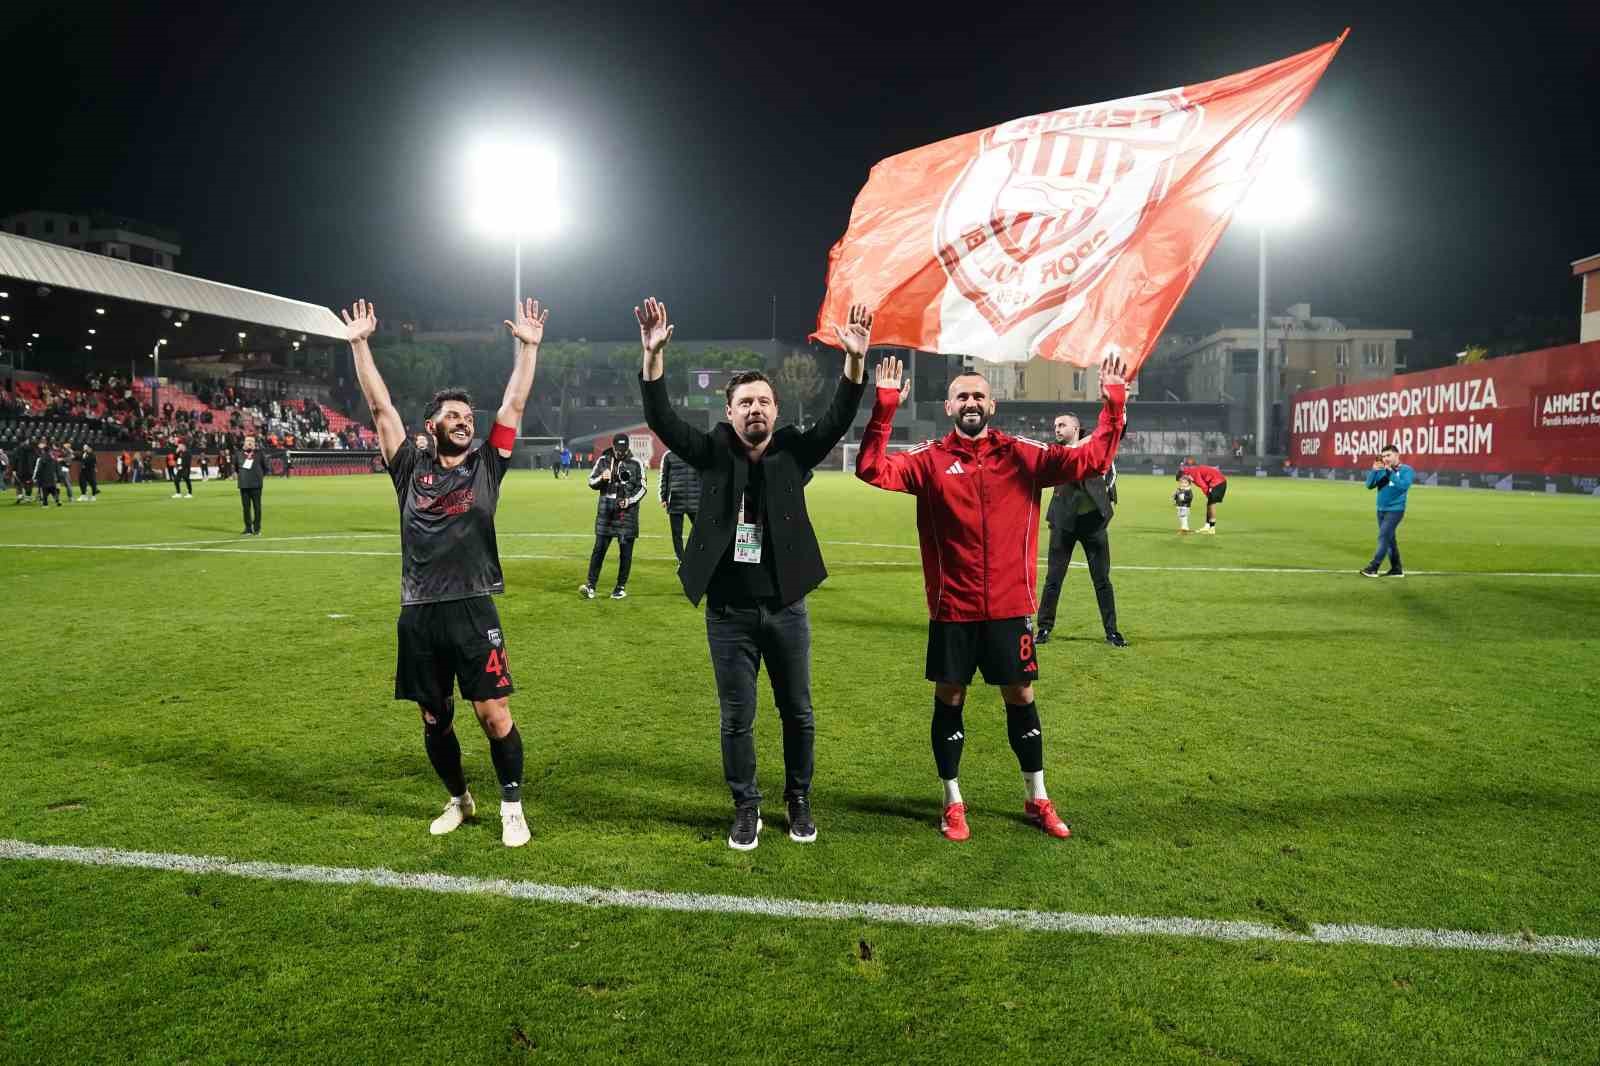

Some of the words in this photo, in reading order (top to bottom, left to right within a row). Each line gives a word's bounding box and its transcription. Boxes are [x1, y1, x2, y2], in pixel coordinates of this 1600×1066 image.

[1293, 398, 1329, 433] ATKO
[1543, 392, 1590, 414] AHMET
[1301, 438, 1320, 456] GRUP
[1416, 415, 1493, 454] DİLERİM
[1020, 634, 1032, 660] 8
